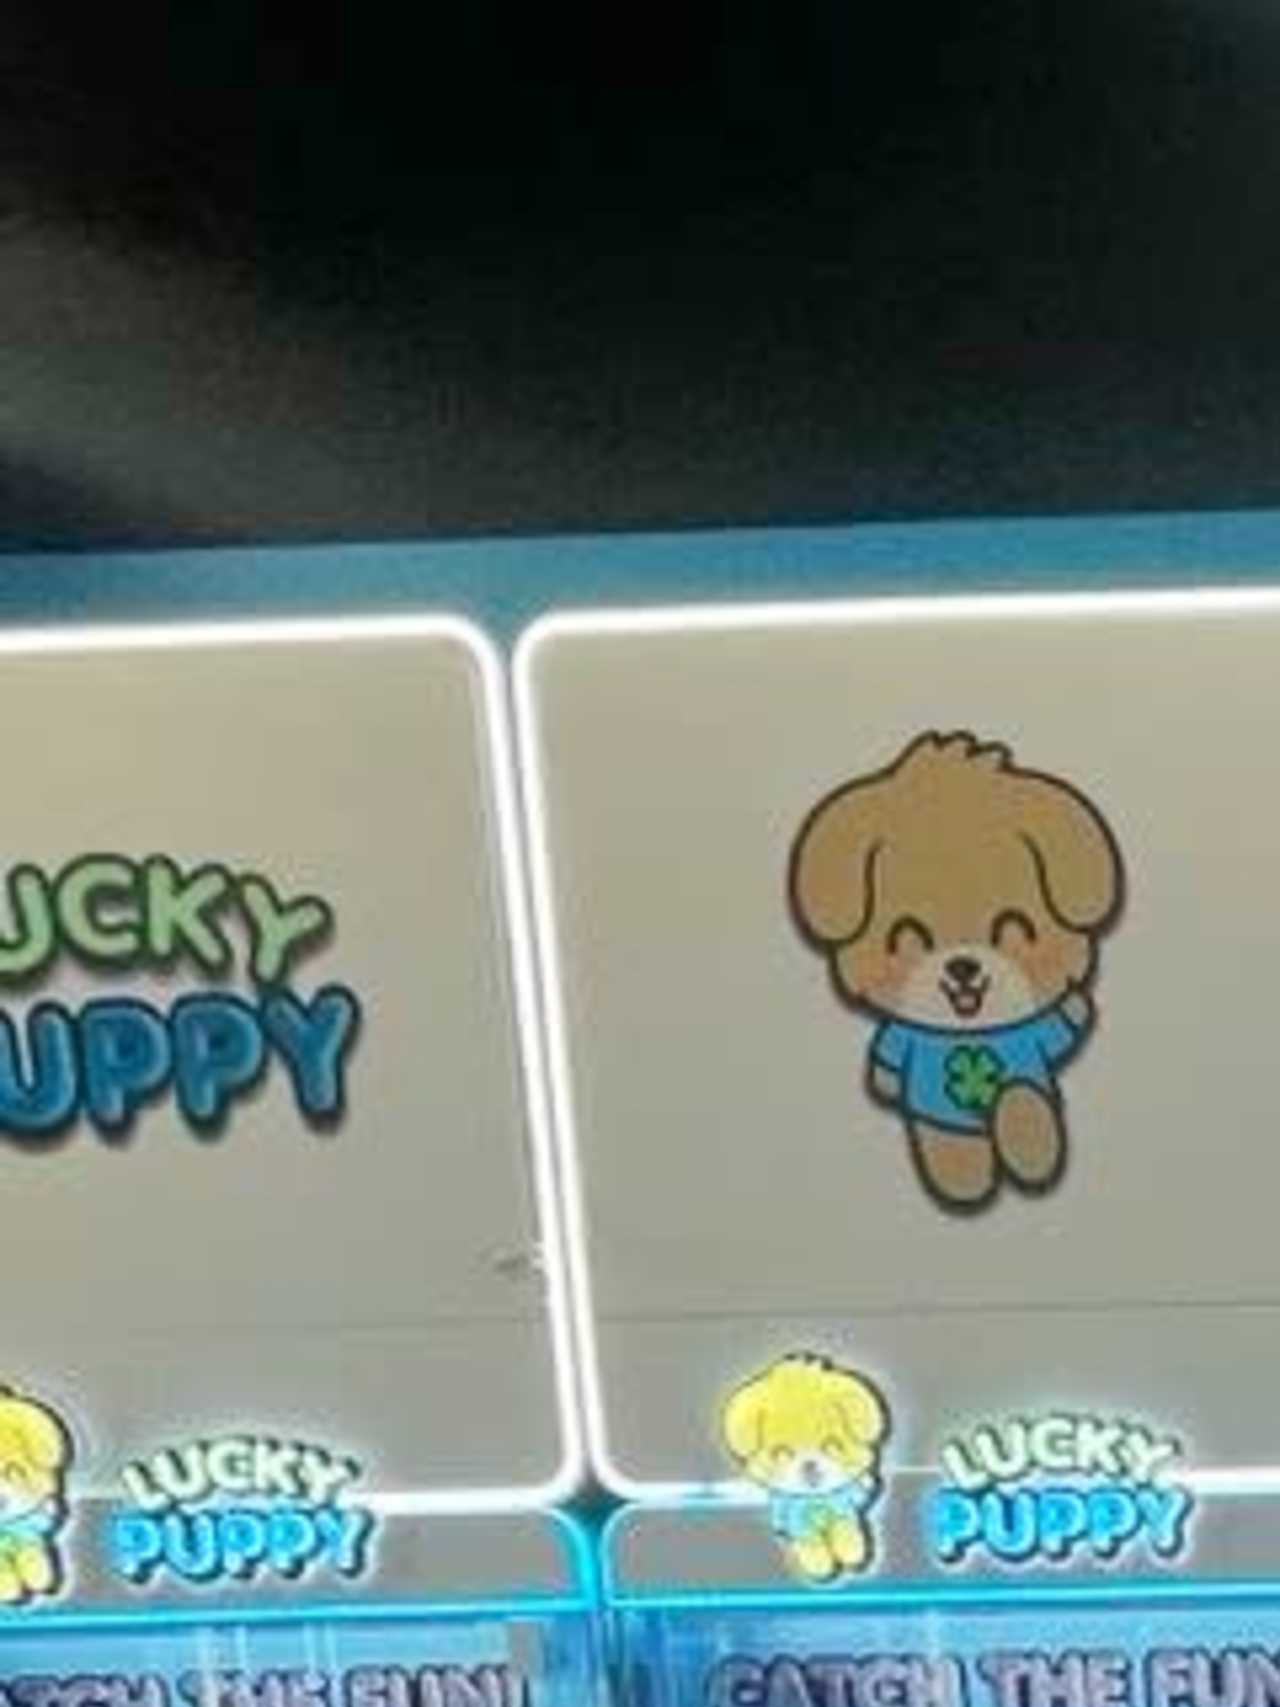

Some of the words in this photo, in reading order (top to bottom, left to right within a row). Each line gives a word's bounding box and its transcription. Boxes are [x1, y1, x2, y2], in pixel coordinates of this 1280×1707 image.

[0, 852, 335, 990] UCKY
[0, 983, 362, 1148] UPPY
[121, 1434, 361, 1507] LUCKY
[934, 1412, 1184, 1489] LUCKY
[109, 1503, 377, 1583] PUPPY
[931, 1484, 1194, 1561] PUPPY
